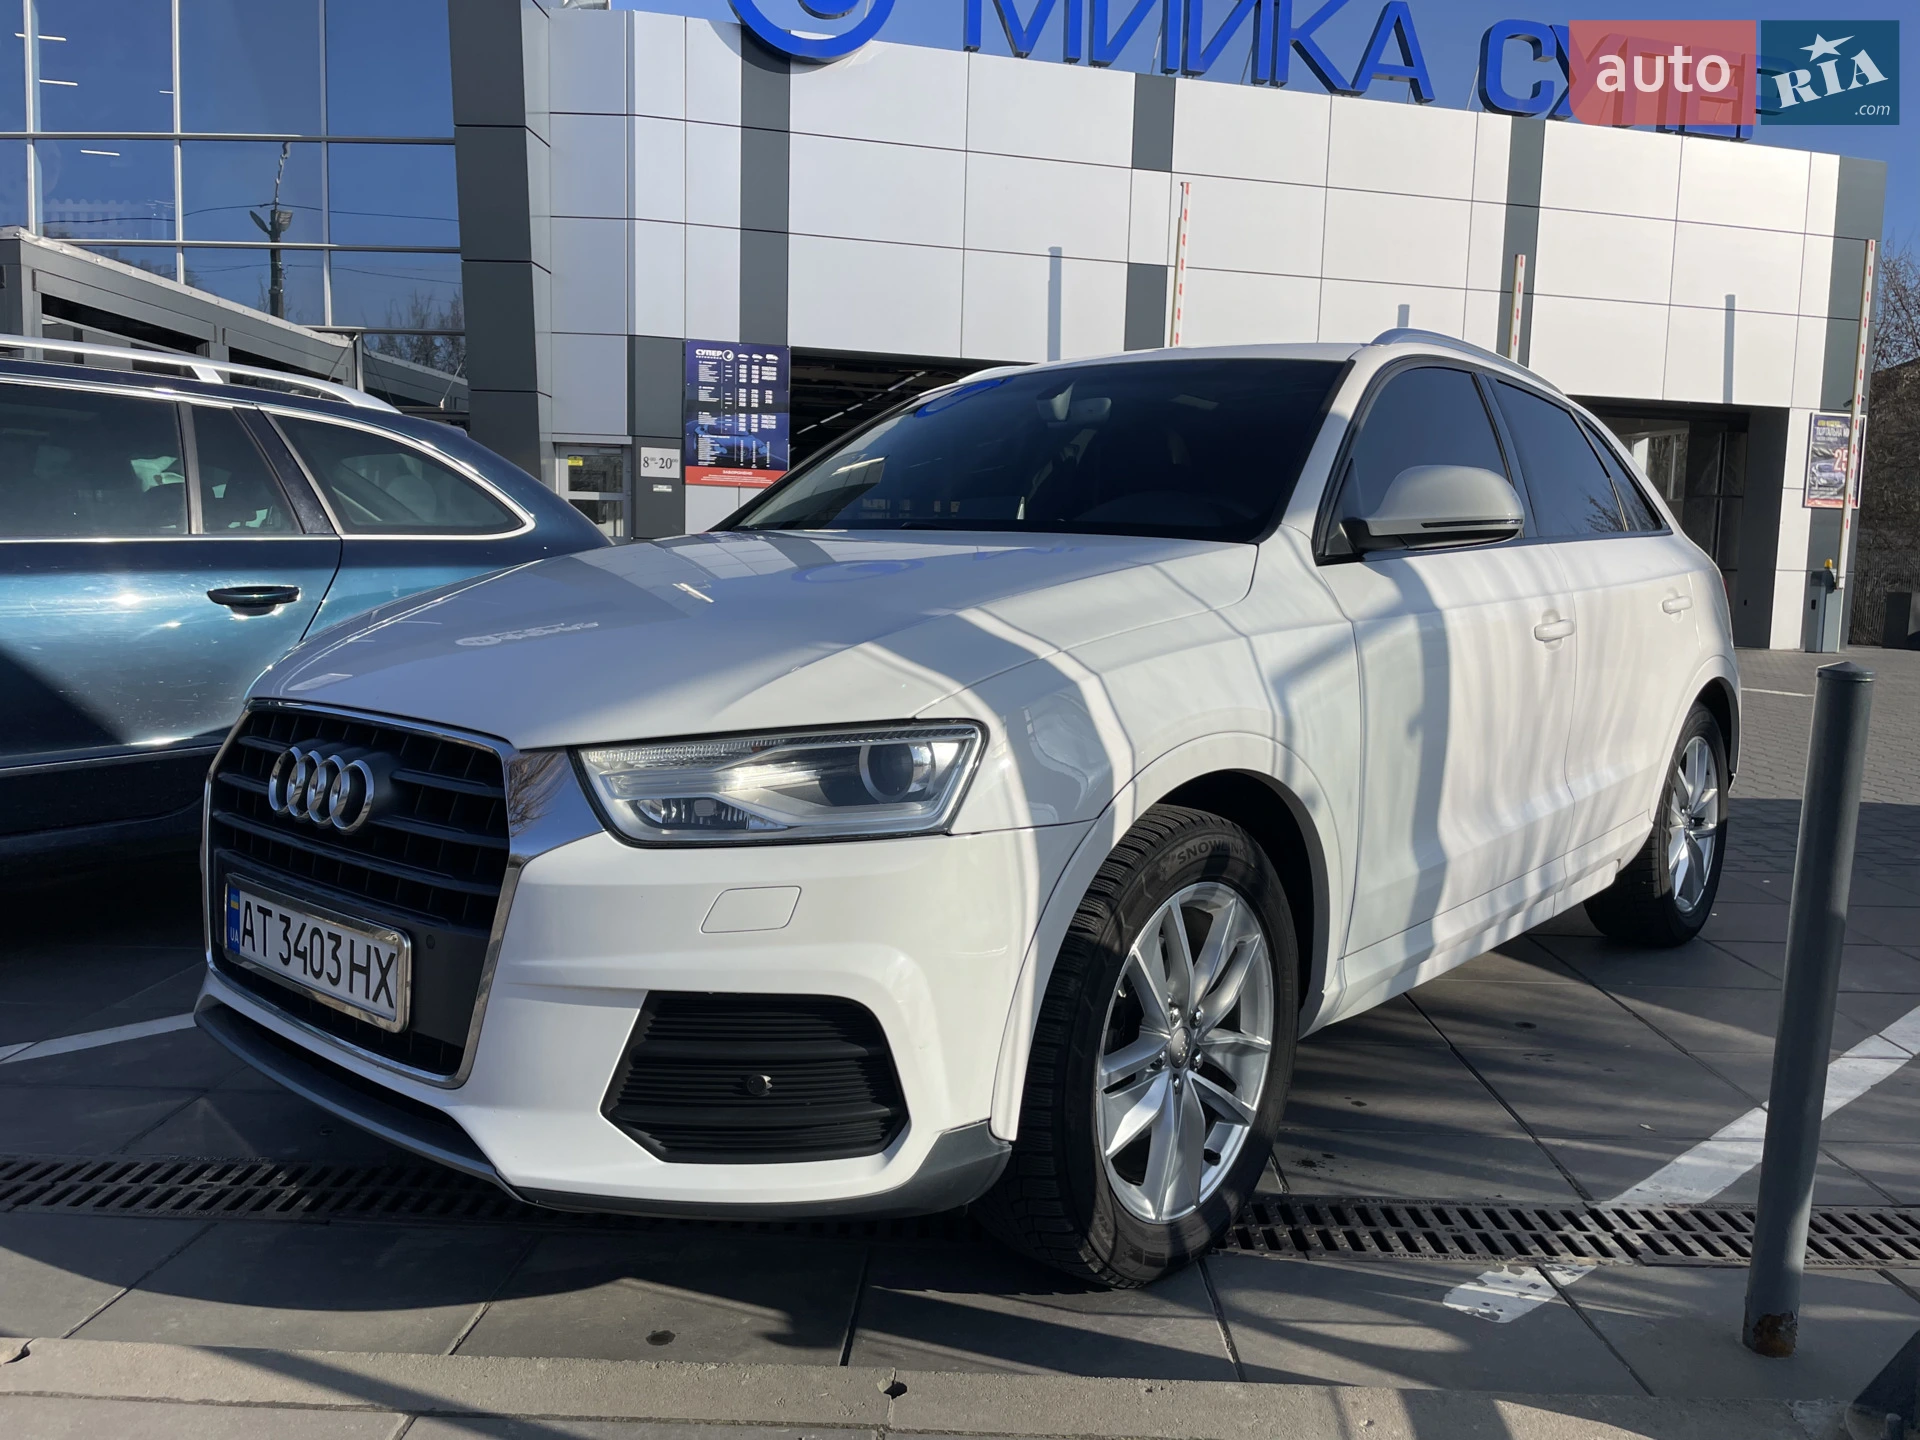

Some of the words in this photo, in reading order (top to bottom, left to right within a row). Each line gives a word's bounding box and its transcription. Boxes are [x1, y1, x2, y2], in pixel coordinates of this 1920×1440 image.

[695, 348, 722, 356] СУПЕР
[229, 926, 239, 944] UA
[241, 900, 272, 957] AT
[278, 913, 342, 986] 3403
[349, 939, 396, 1009] HX
